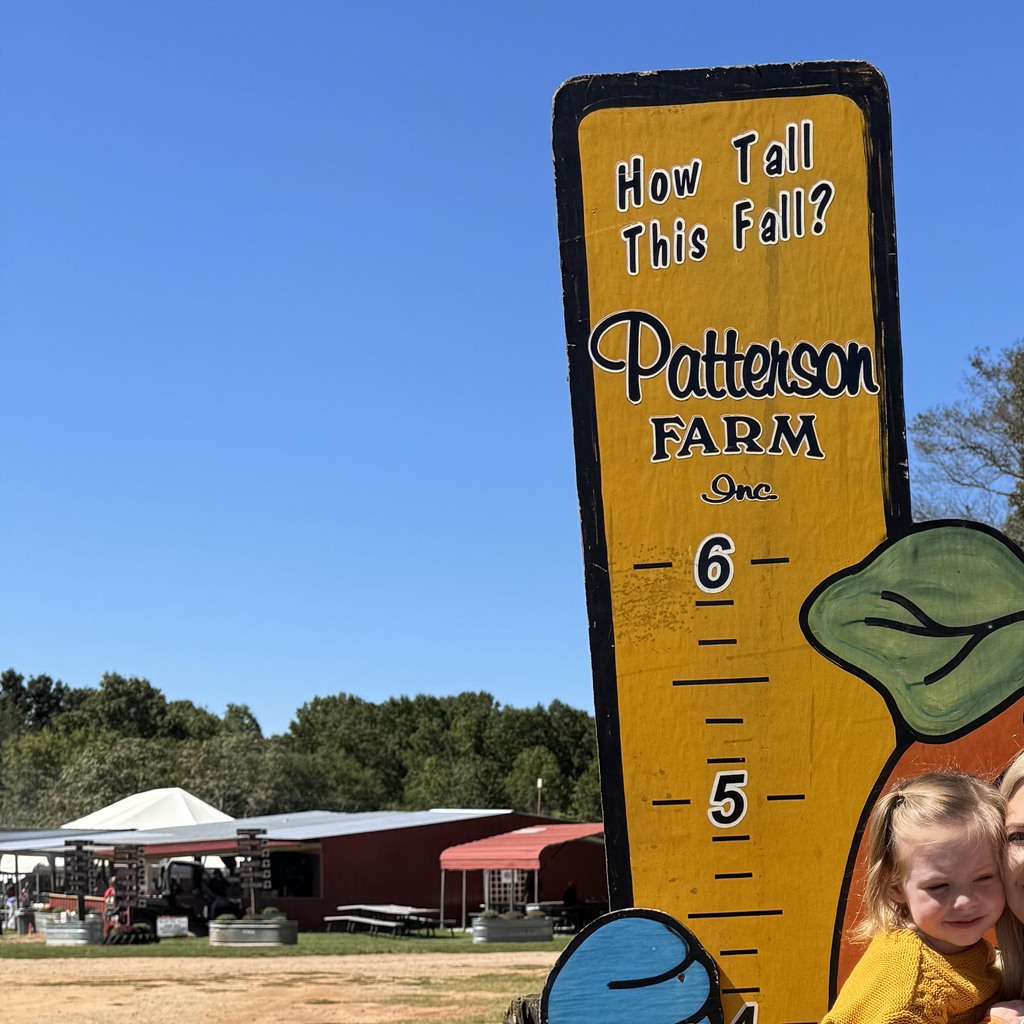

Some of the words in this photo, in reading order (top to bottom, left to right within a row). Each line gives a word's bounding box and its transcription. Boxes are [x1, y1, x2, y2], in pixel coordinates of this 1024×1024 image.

[616, 154, 701, 212] How
[732, 119, 813, 184] Tall
[621, 218, 708, 275] This
[733, 181, 834, 251] Fall?
[588, 310, 880, 404] Patterson
[650, 414, 825, 463] FARM
[694, 533, 735, 593] 6
[707, 770, 748, 828] 5
